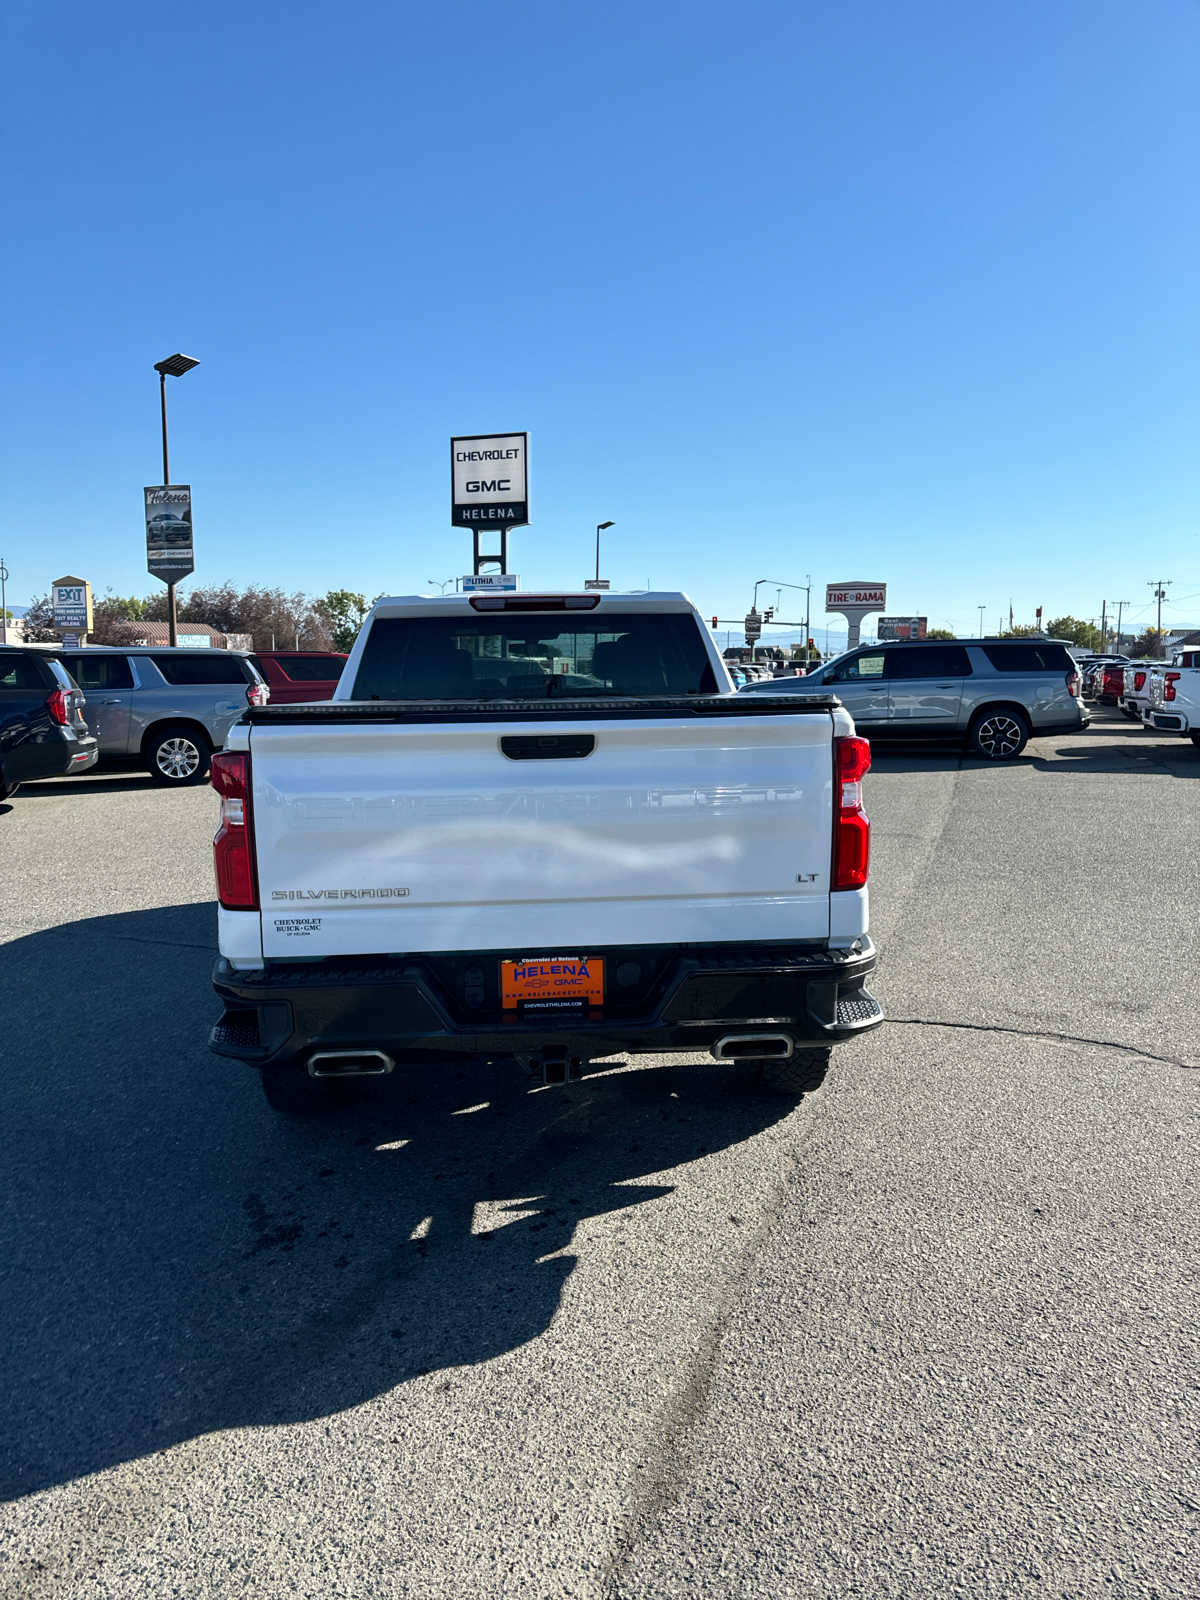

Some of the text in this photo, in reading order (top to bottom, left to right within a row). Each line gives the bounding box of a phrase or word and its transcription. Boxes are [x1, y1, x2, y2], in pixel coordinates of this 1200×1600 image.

[456, 448, 520, 462] CHEVROLET
[465, 479, 511, 493] GMC
[149, 489, 188, 504] Helena
[462, 508, 515, 520] HELENA
[471, 577, 494, 585] LITHIA
[57, 588, 83, 602] EXIT
[828, 591, 884, 602] TIRE RAMA
[797, 873, 820, 883] LT
[271, 888, 410, 901] SILVERADO
[273, 918, 322, 926] CHEVROLET
[513, 964, 591, 982] HELENA
[554, 978, 584, 986] GMC
